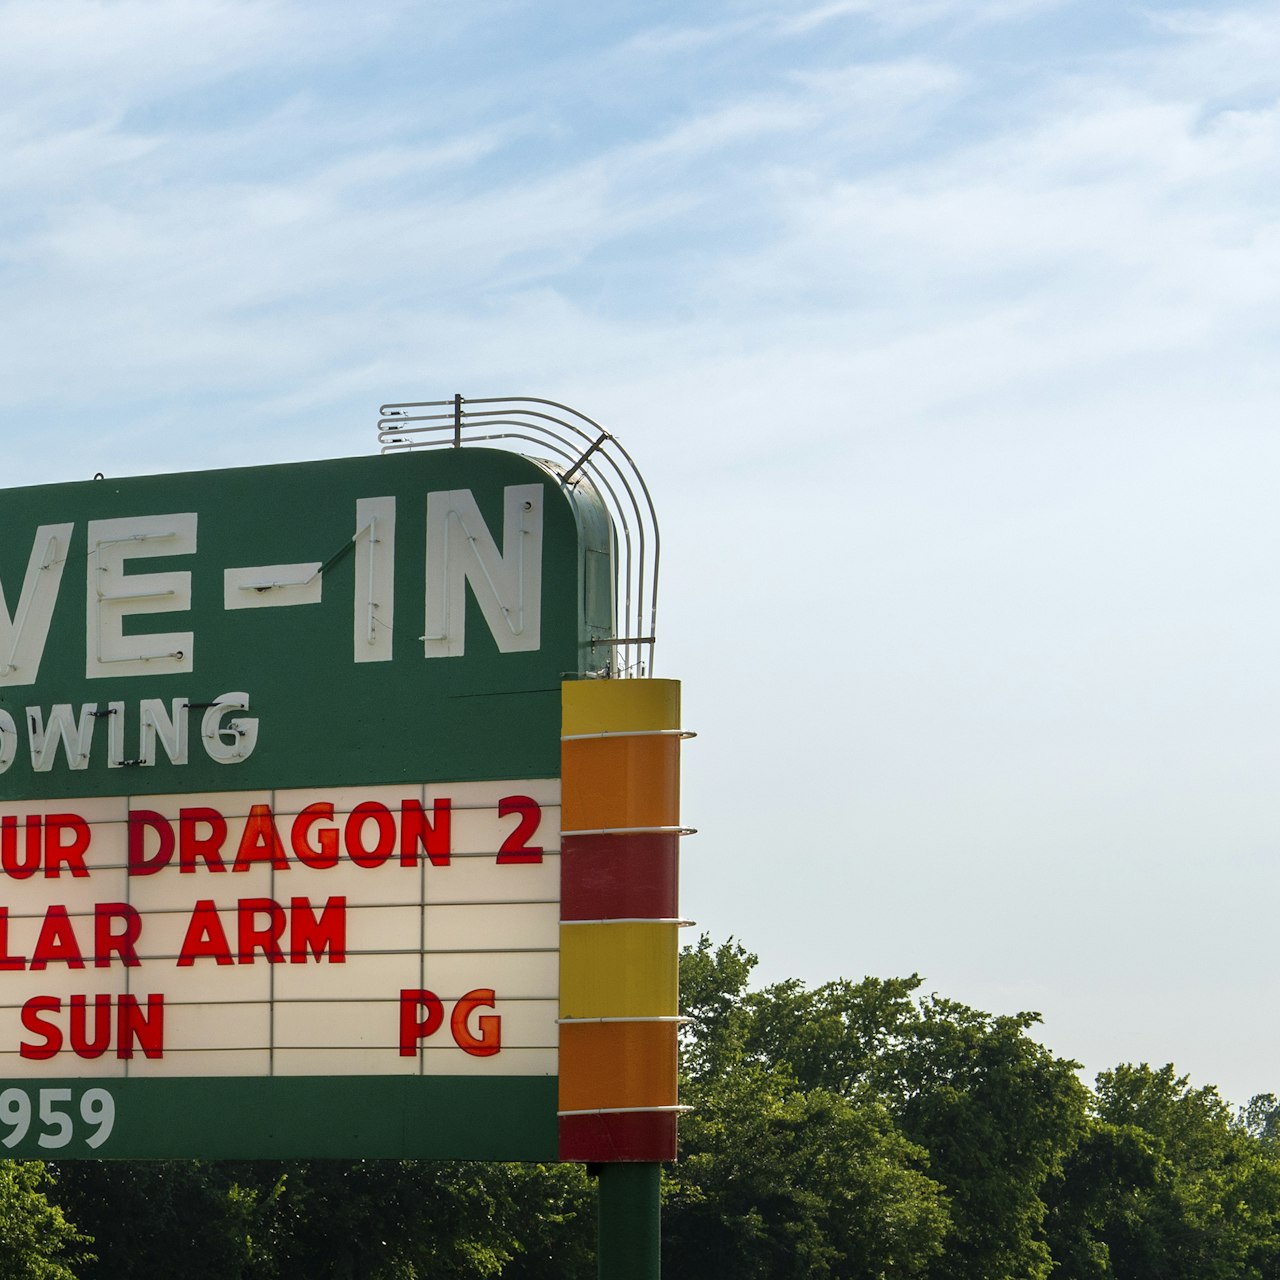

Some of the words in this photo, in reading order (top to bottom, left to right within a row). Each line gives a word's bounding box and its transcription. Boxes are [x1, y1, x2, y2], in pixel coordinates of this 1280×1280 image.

[128, 798, 452, 877] DRAGON
[496, 795, 544, 865] 2
[176, 896, 347, 966] ARM
[19, 993, 164, 1061] SUN
[399, 988, 502, 1057] PG
